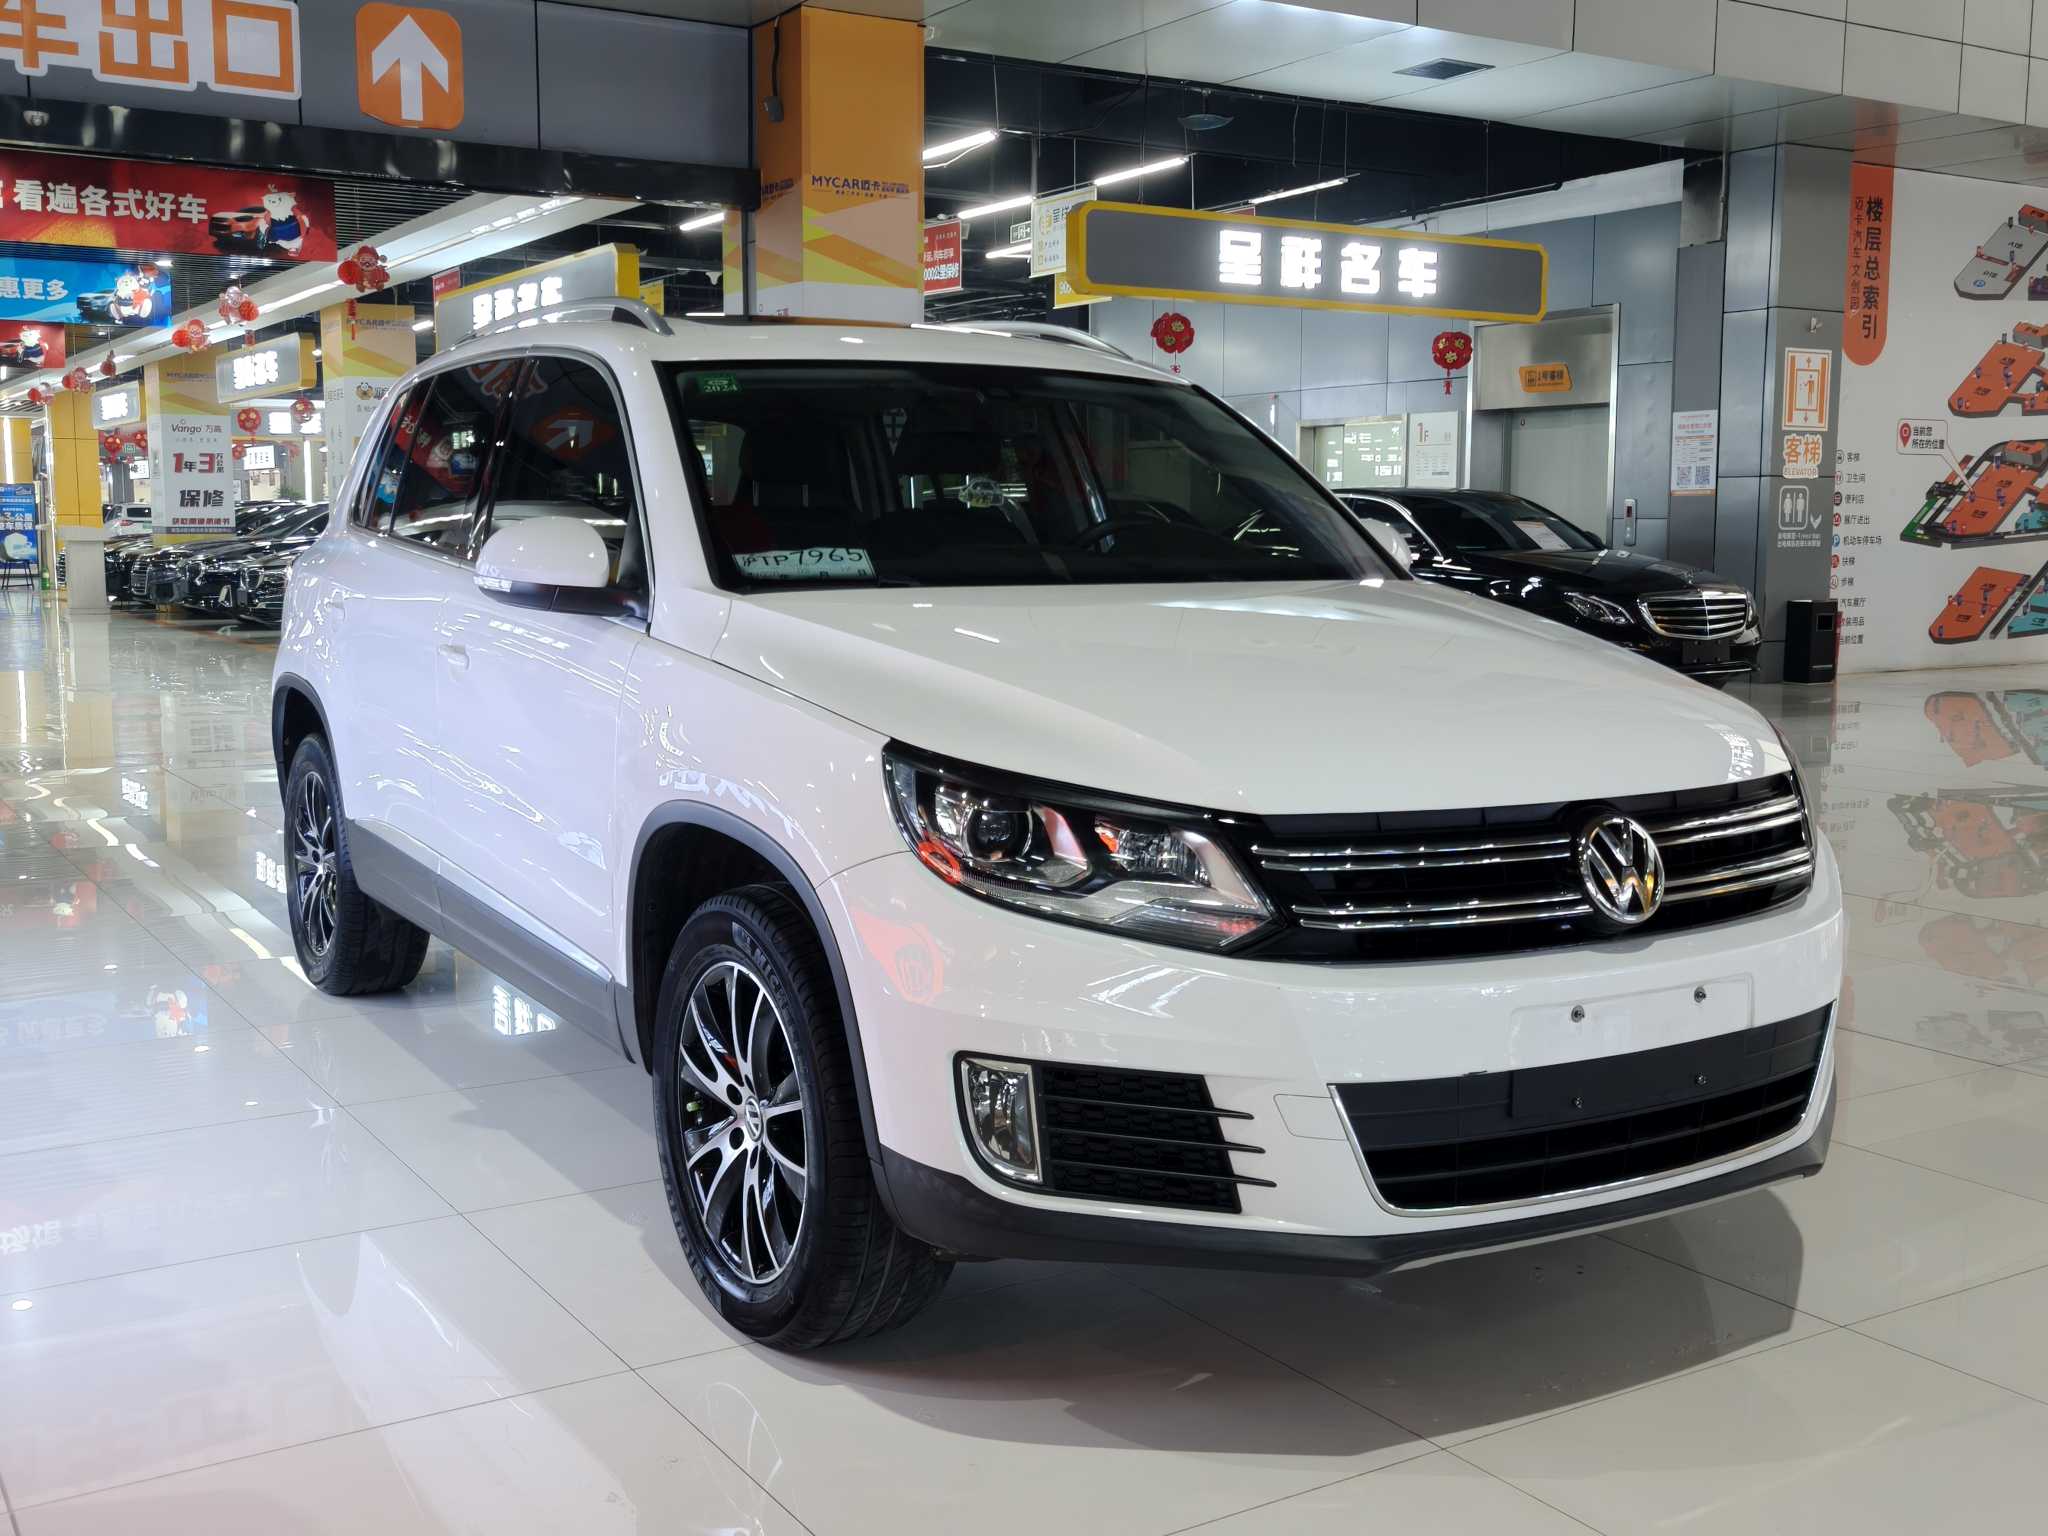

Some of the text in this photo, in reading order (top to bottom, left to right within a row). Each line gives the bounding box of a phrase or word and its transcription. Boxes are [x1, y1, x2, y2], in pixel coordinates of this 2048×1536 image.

[13, 179, 209, 225] 看遍各式好车
[1862, 196, 1884, 340] 楼层总索引
[0, 276, 69, 301] 惠更多
[1785, 435, 1821, 465] 客梯
[1911, 439, 1945, 450] 所在的位置
[179, 489, 224, 508] 保修
